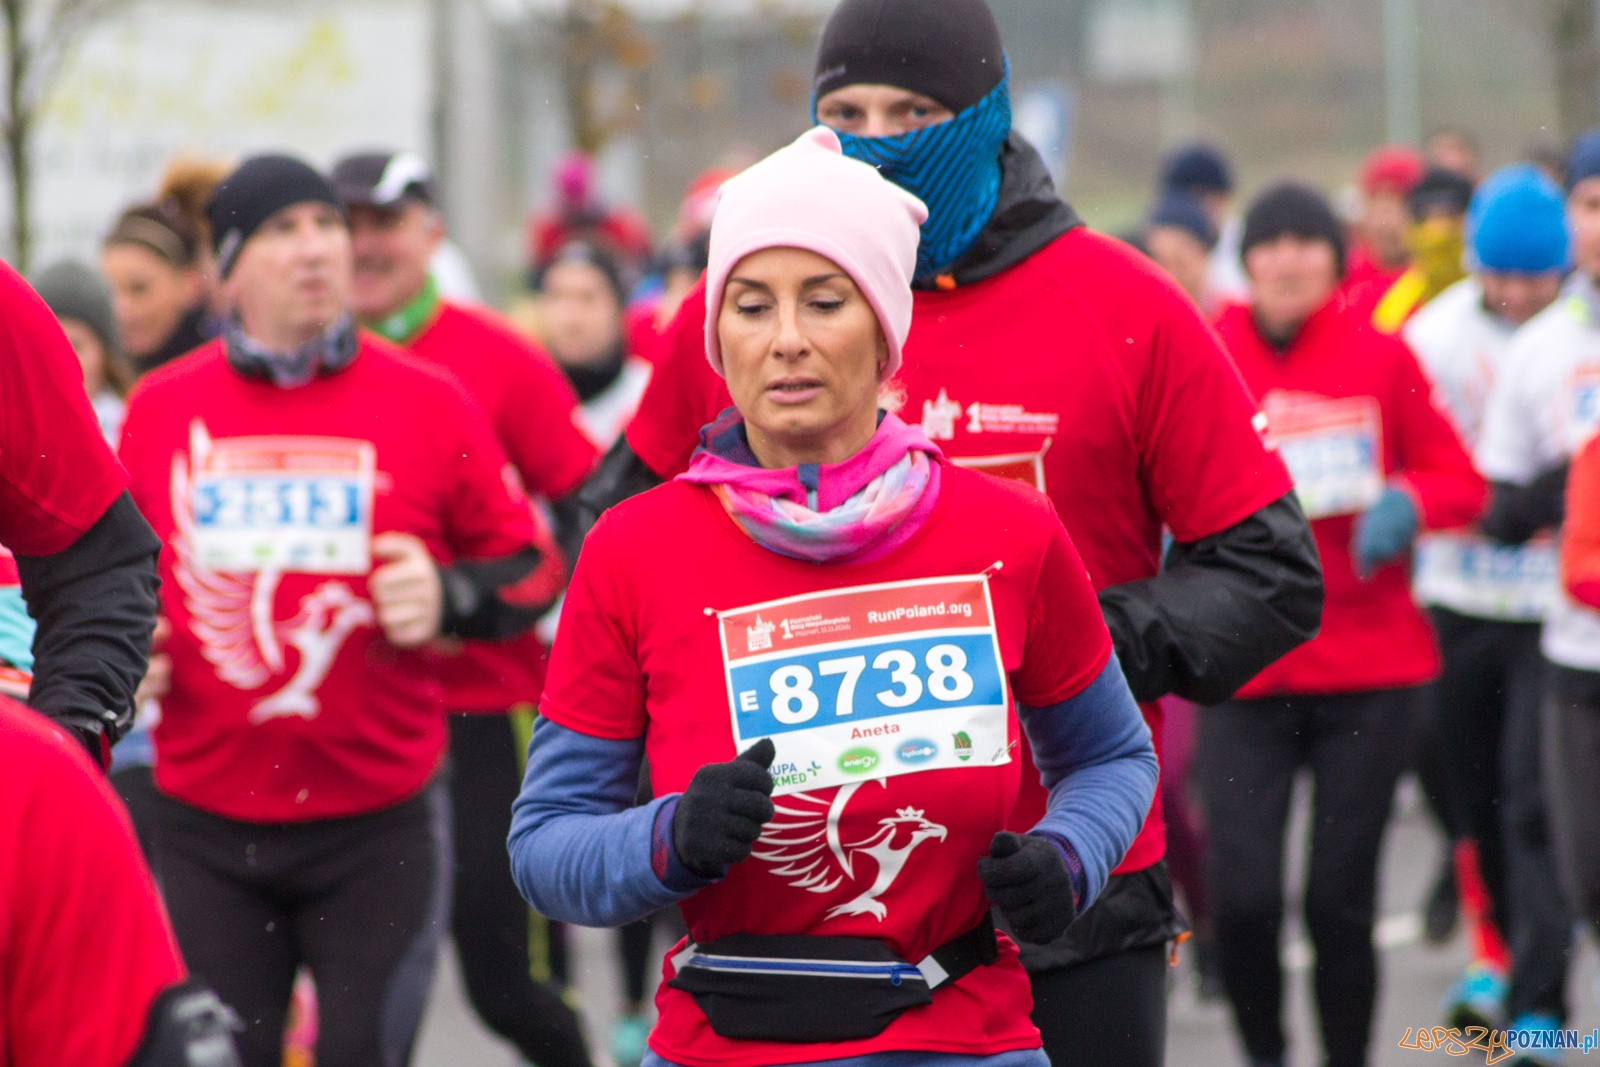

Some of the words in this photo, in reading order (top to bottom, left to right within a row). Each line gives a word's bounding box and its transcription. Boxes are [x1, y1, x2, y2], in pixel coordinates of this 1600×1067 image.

[966, 401, 982, 433] 1
[867, 602, 972, 624] RunPoland.org
[779, 618, 794, 639] 1
[769, 643, 974, 724] 8738
[739, 690, 759, 712] E
[850, 722, 901, 740] Aneta
[843, 756, 876, 768] energy
